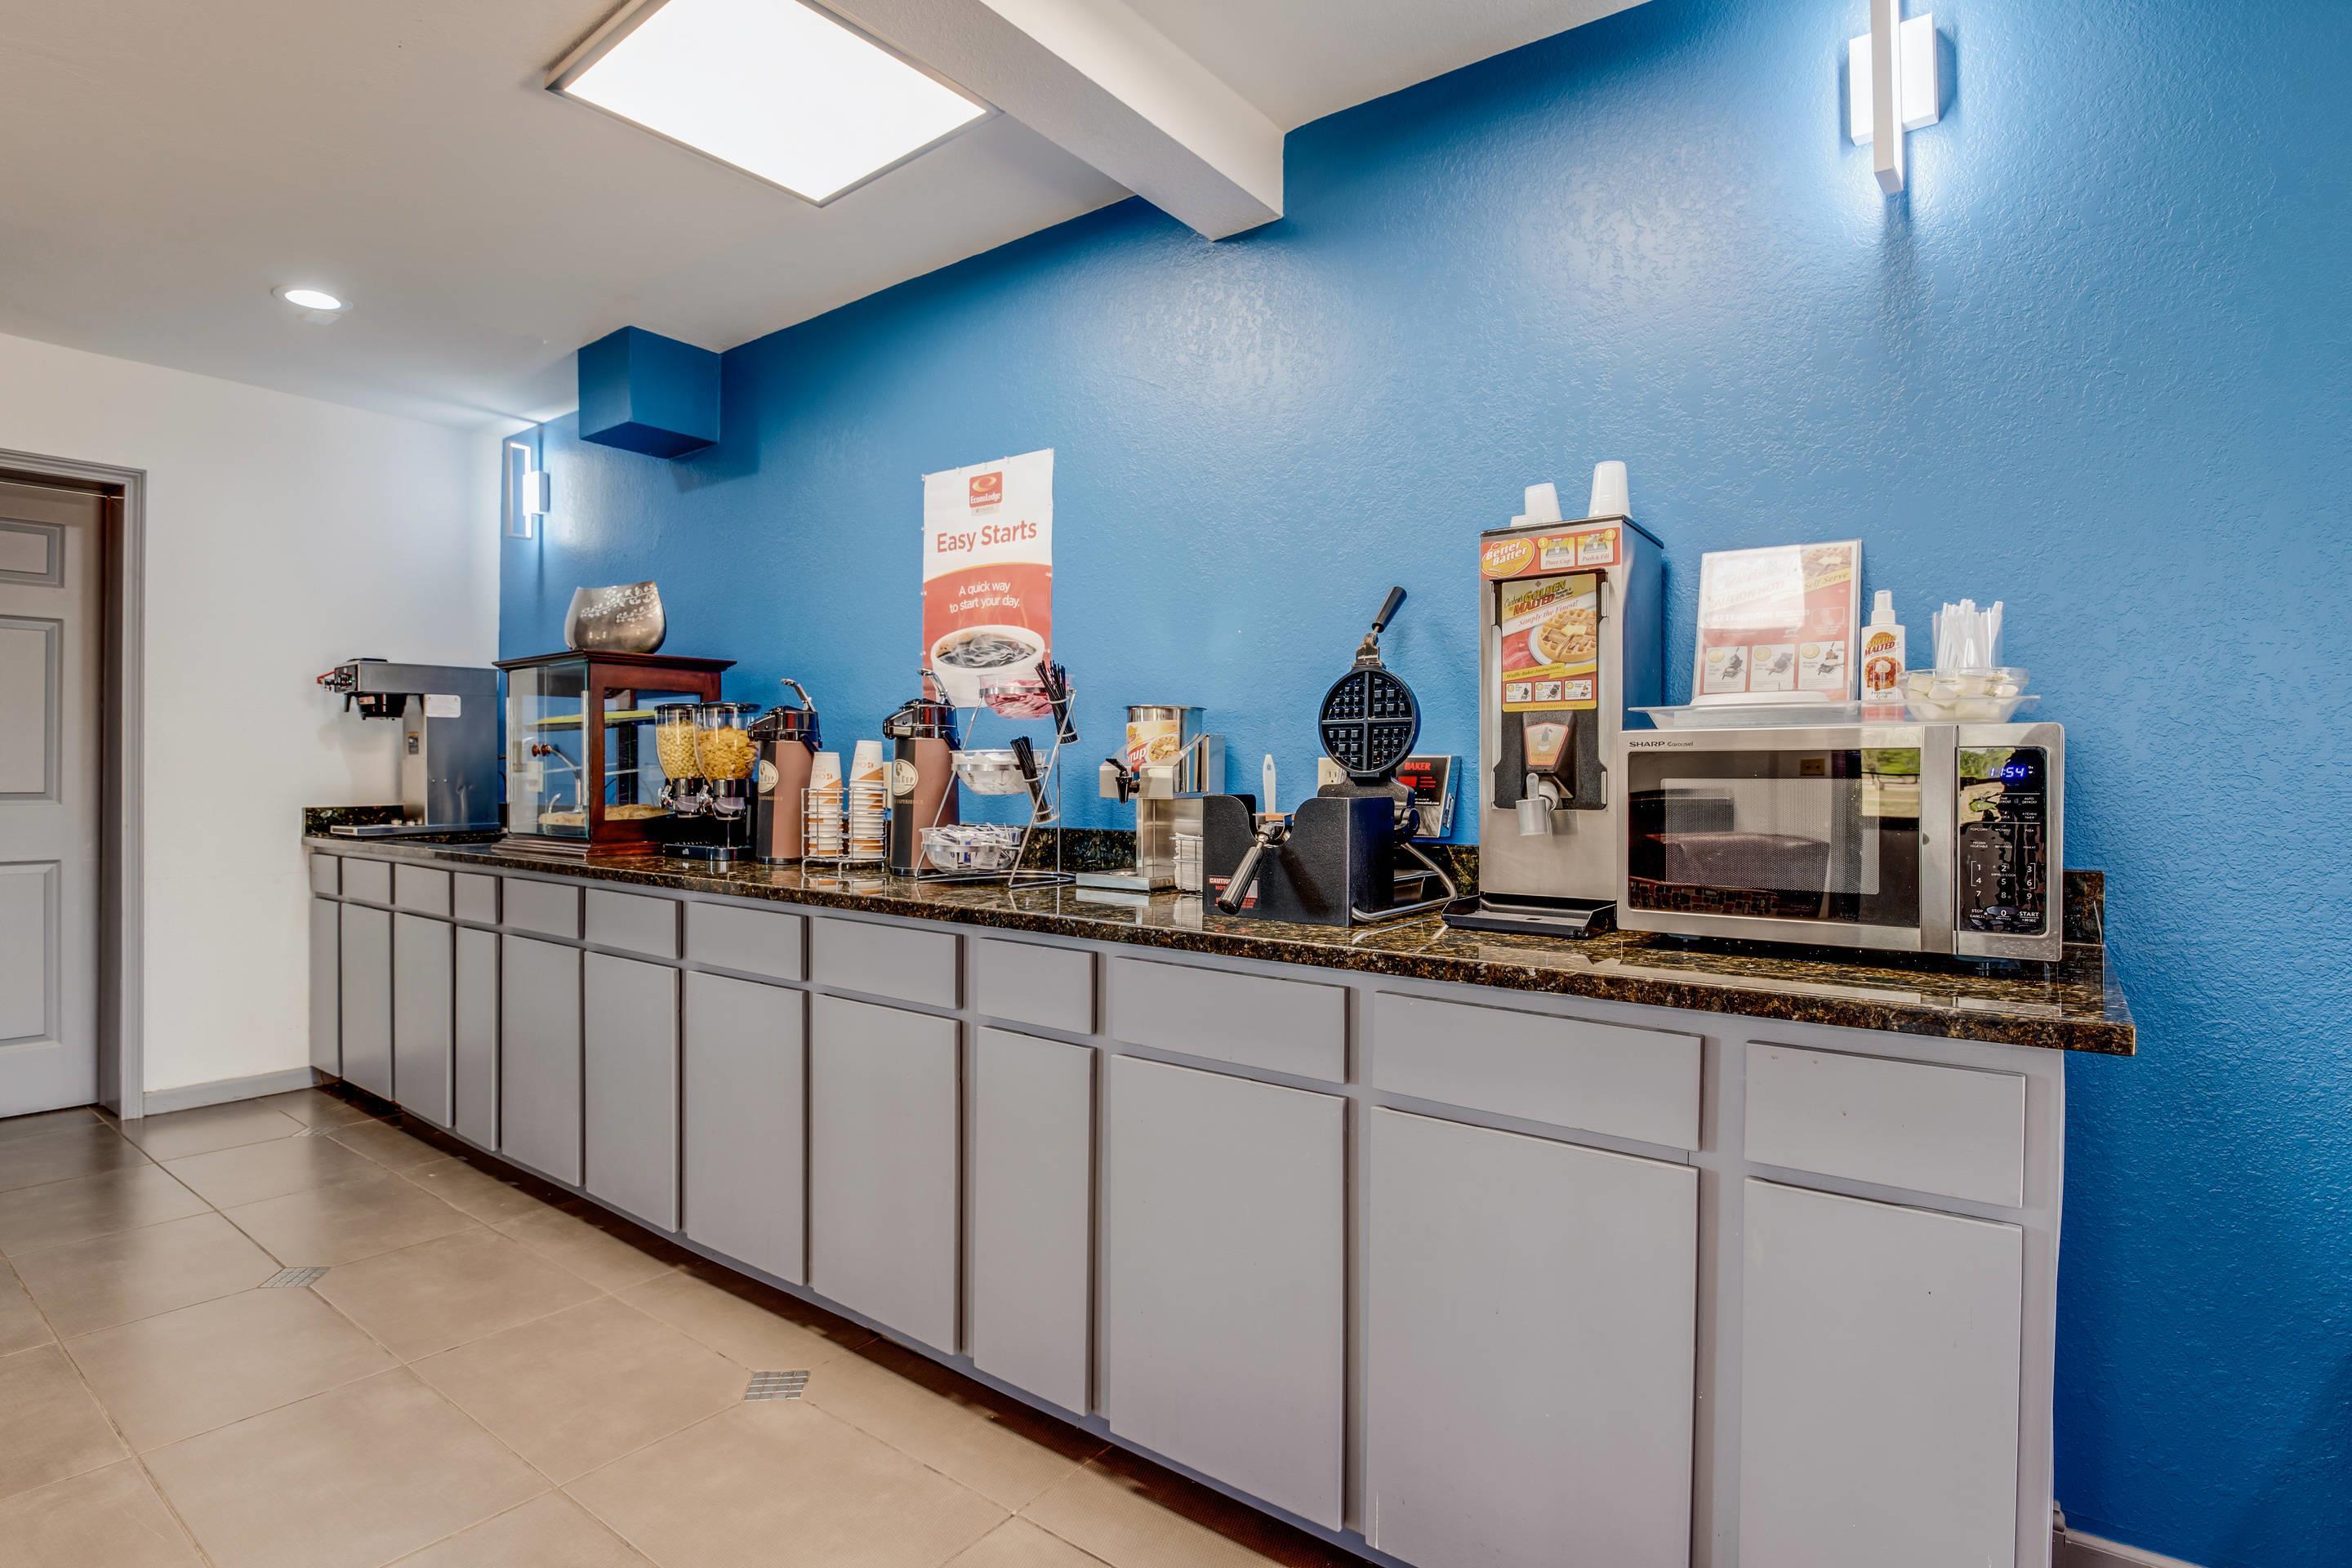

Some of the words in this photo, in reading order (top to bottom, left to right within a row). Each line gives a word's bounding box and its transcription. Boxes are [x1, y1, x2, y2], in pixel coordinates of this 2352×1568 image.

[937, 532, 978, 553] Easy
[981, 520, 1037, 546] Starts
[1486, 541, 1521, 561] Better
[1492, 546, 1527, 567] Batter
[1824, 572, 1849, 583] Serve
[959, 586, 966, 596] A
[967, 581, 991, 595] quick
[991, 581, 1011, 593] way
[1524, 580, 1567, 603] GOLDEN
[949, 604, 959, 613] to
[960, 597, 979, 611] start
[981, 596, 1001, 609] your
[1002, 594, 1020, 608] day.
[1513, 594, 1556, 616] MALTED
[1864, 641, 1895, 657] MALTED
[1405, 762, 1431, 771] BAKER
[1990, 767, 2025, 777] 11:54
